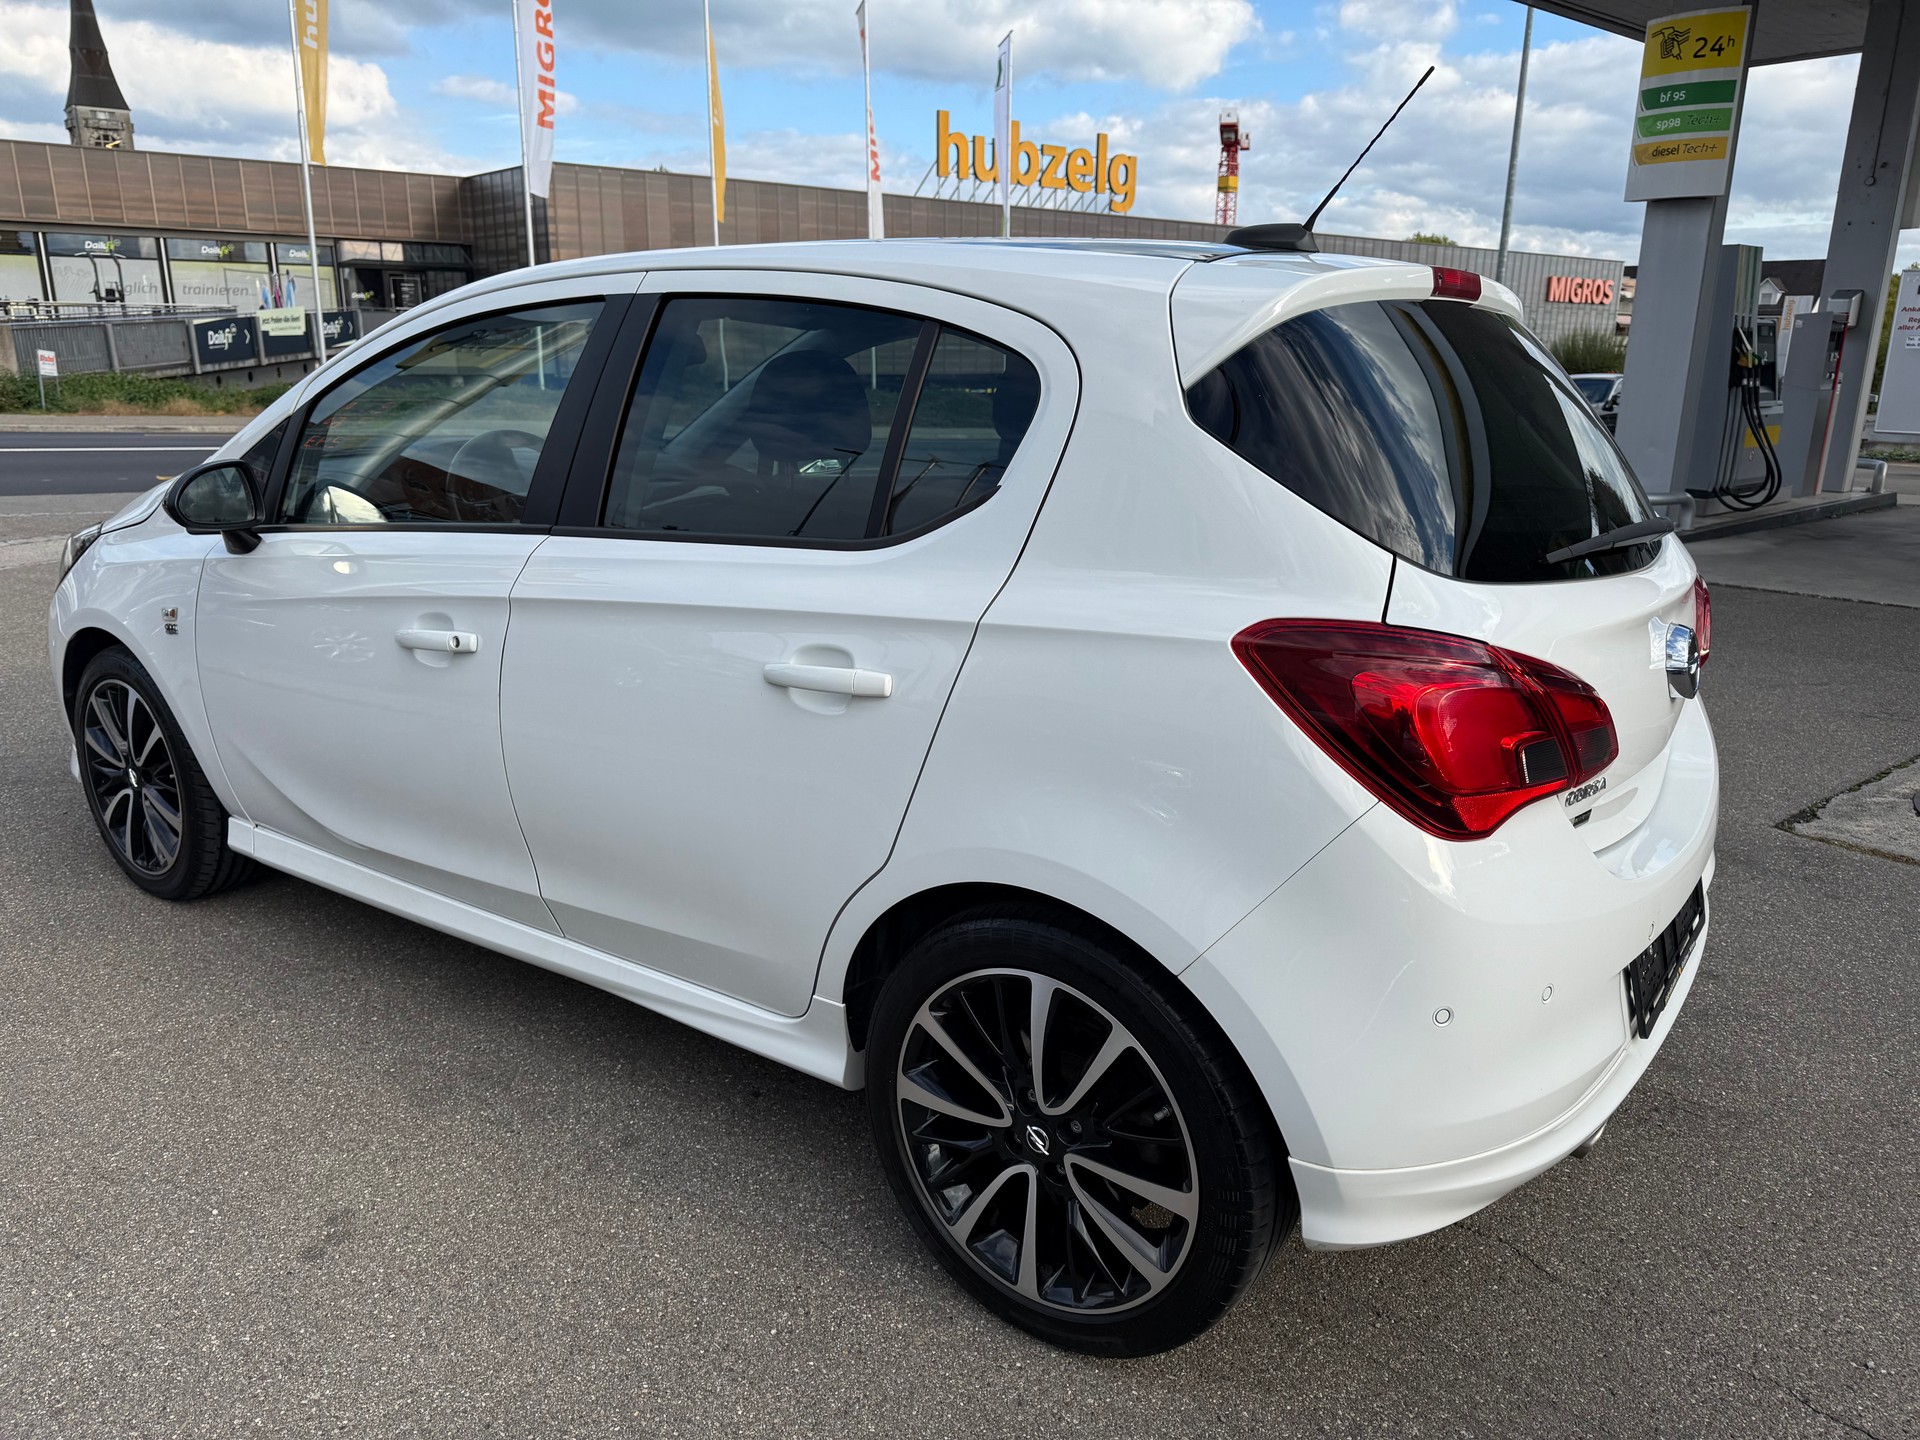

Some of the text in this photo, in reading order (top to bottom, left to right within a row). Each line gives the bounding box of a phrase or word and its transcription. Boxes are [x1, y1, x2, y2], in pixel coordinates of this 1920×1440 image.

[1660, 90, 1686, 103] bf 95
[1656, 118, 1681, 131] sp98
[1652, 142, 1718, 157] diesel Tech+
[937, 110, 1137, 213] hubzelg
[1546, 276, 1614, 304] MIGROS
